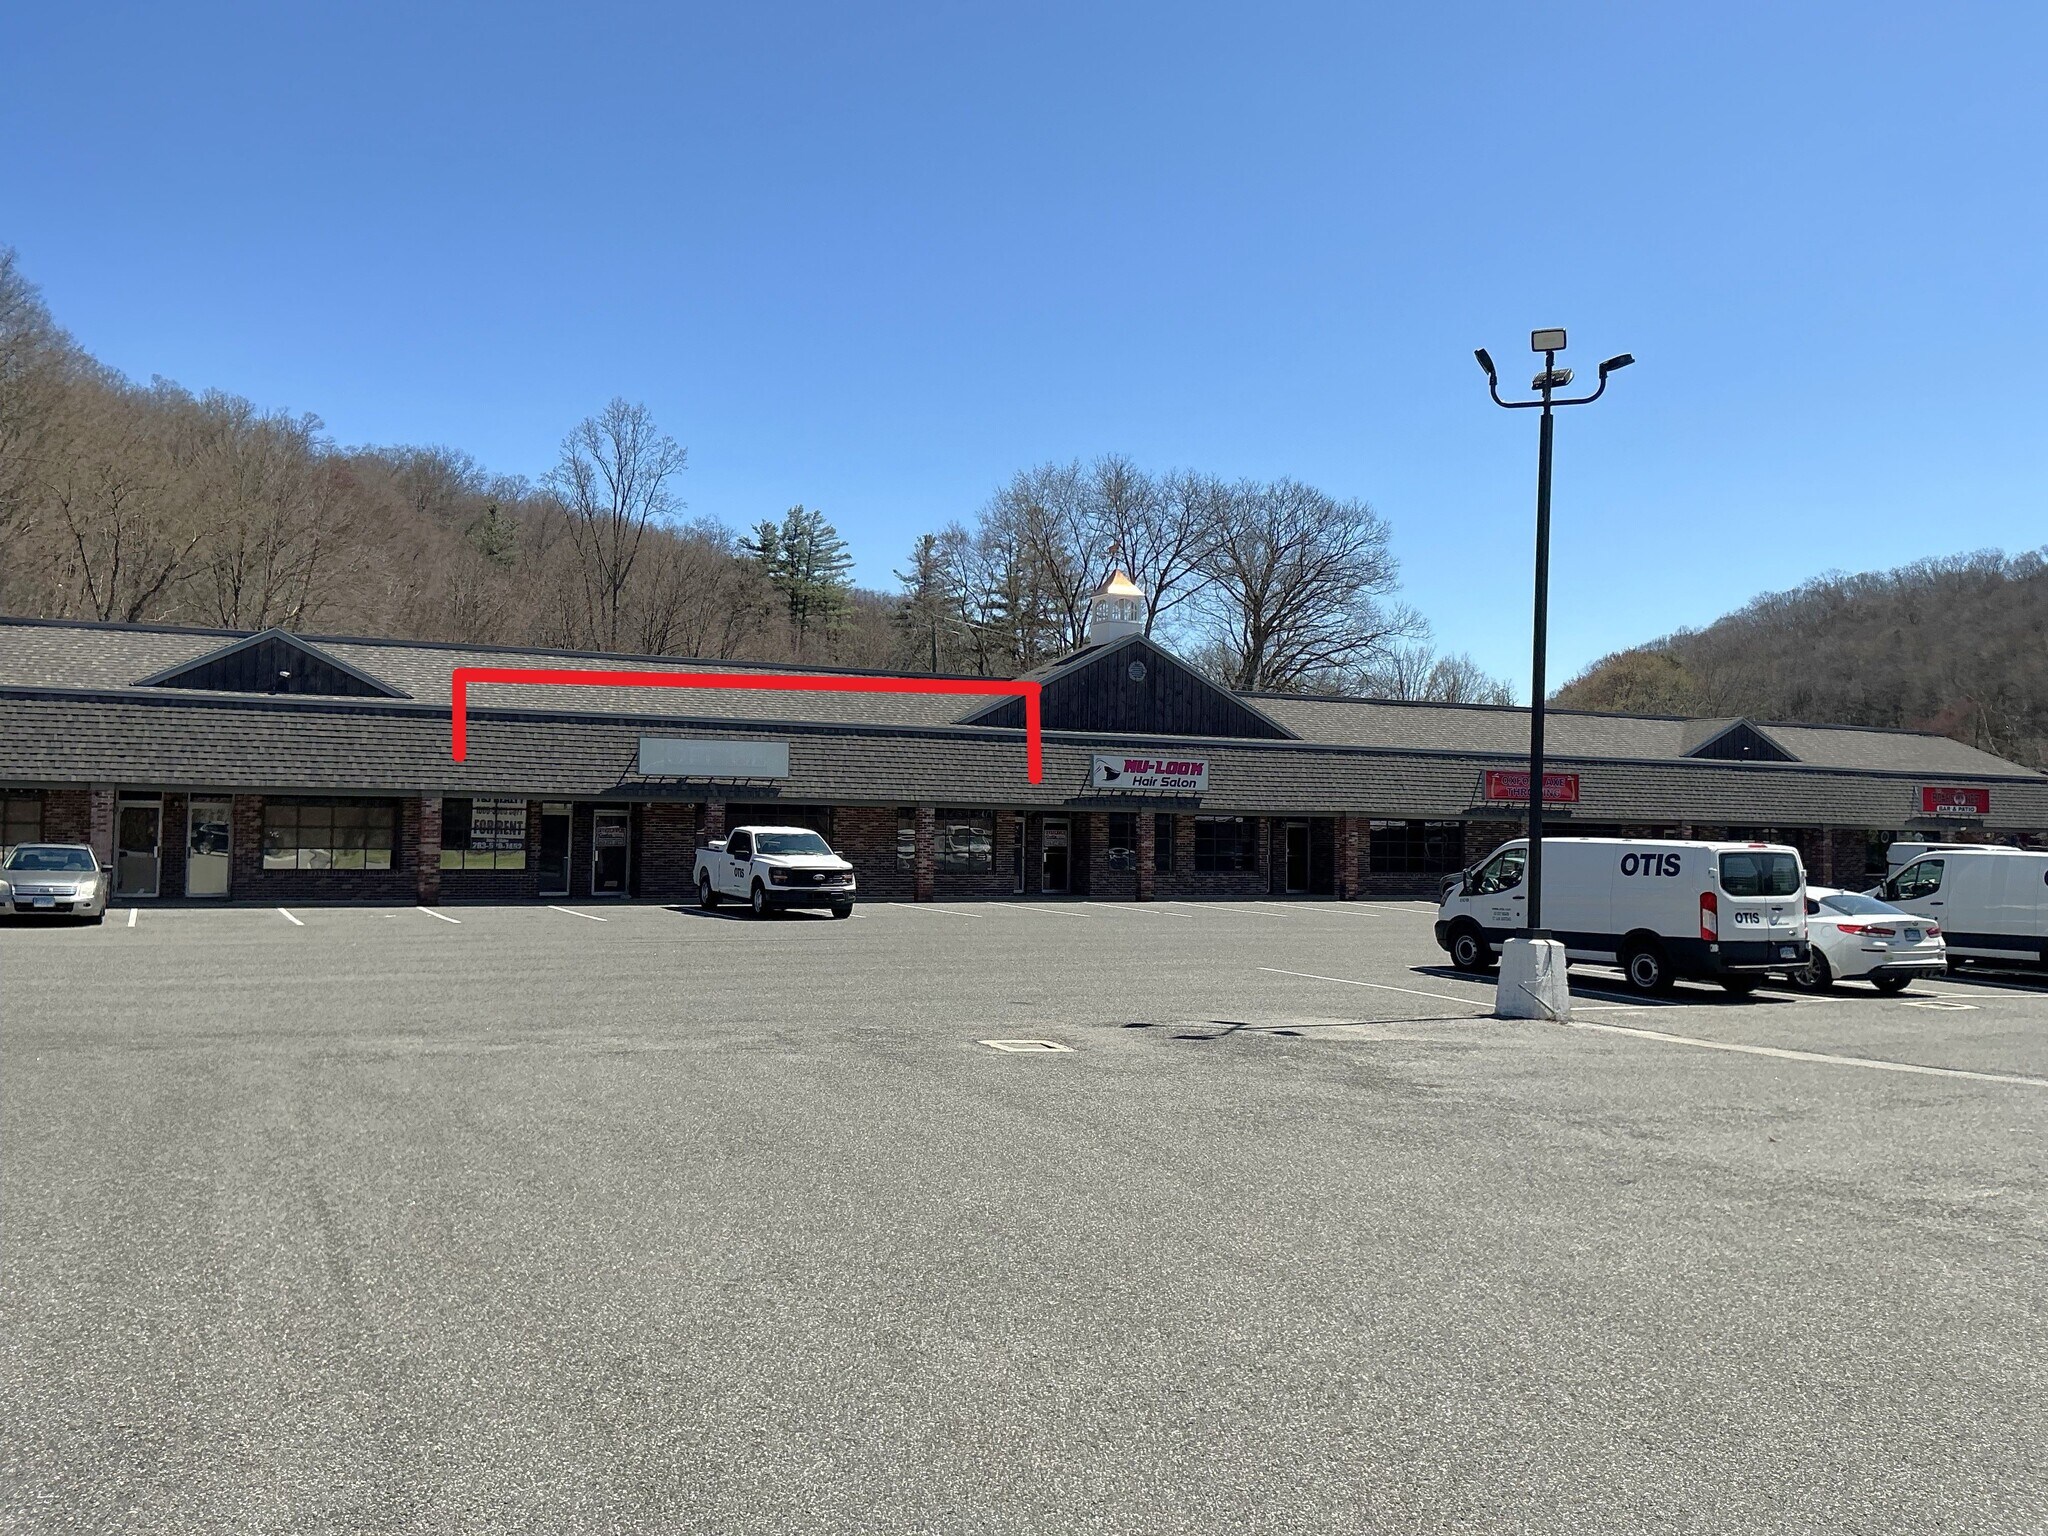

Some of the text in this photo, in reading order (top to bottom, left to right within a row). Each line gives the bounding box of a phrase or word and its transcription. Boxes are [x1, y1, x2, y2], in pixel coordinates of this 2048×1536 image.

[1123, 759, 1205, 776] NU-LOOK
[1132, 775, 1197, 788] Hair Salon
[1501, 775, 1566, 788] OXFO AXE
[1507, 786, 1561, 799] THRING
[474, 819, 523, 836] FOR RENT
[1620, 853, 1681, 877] OTIS
[1734, 911, 1760, 924] OTIS
